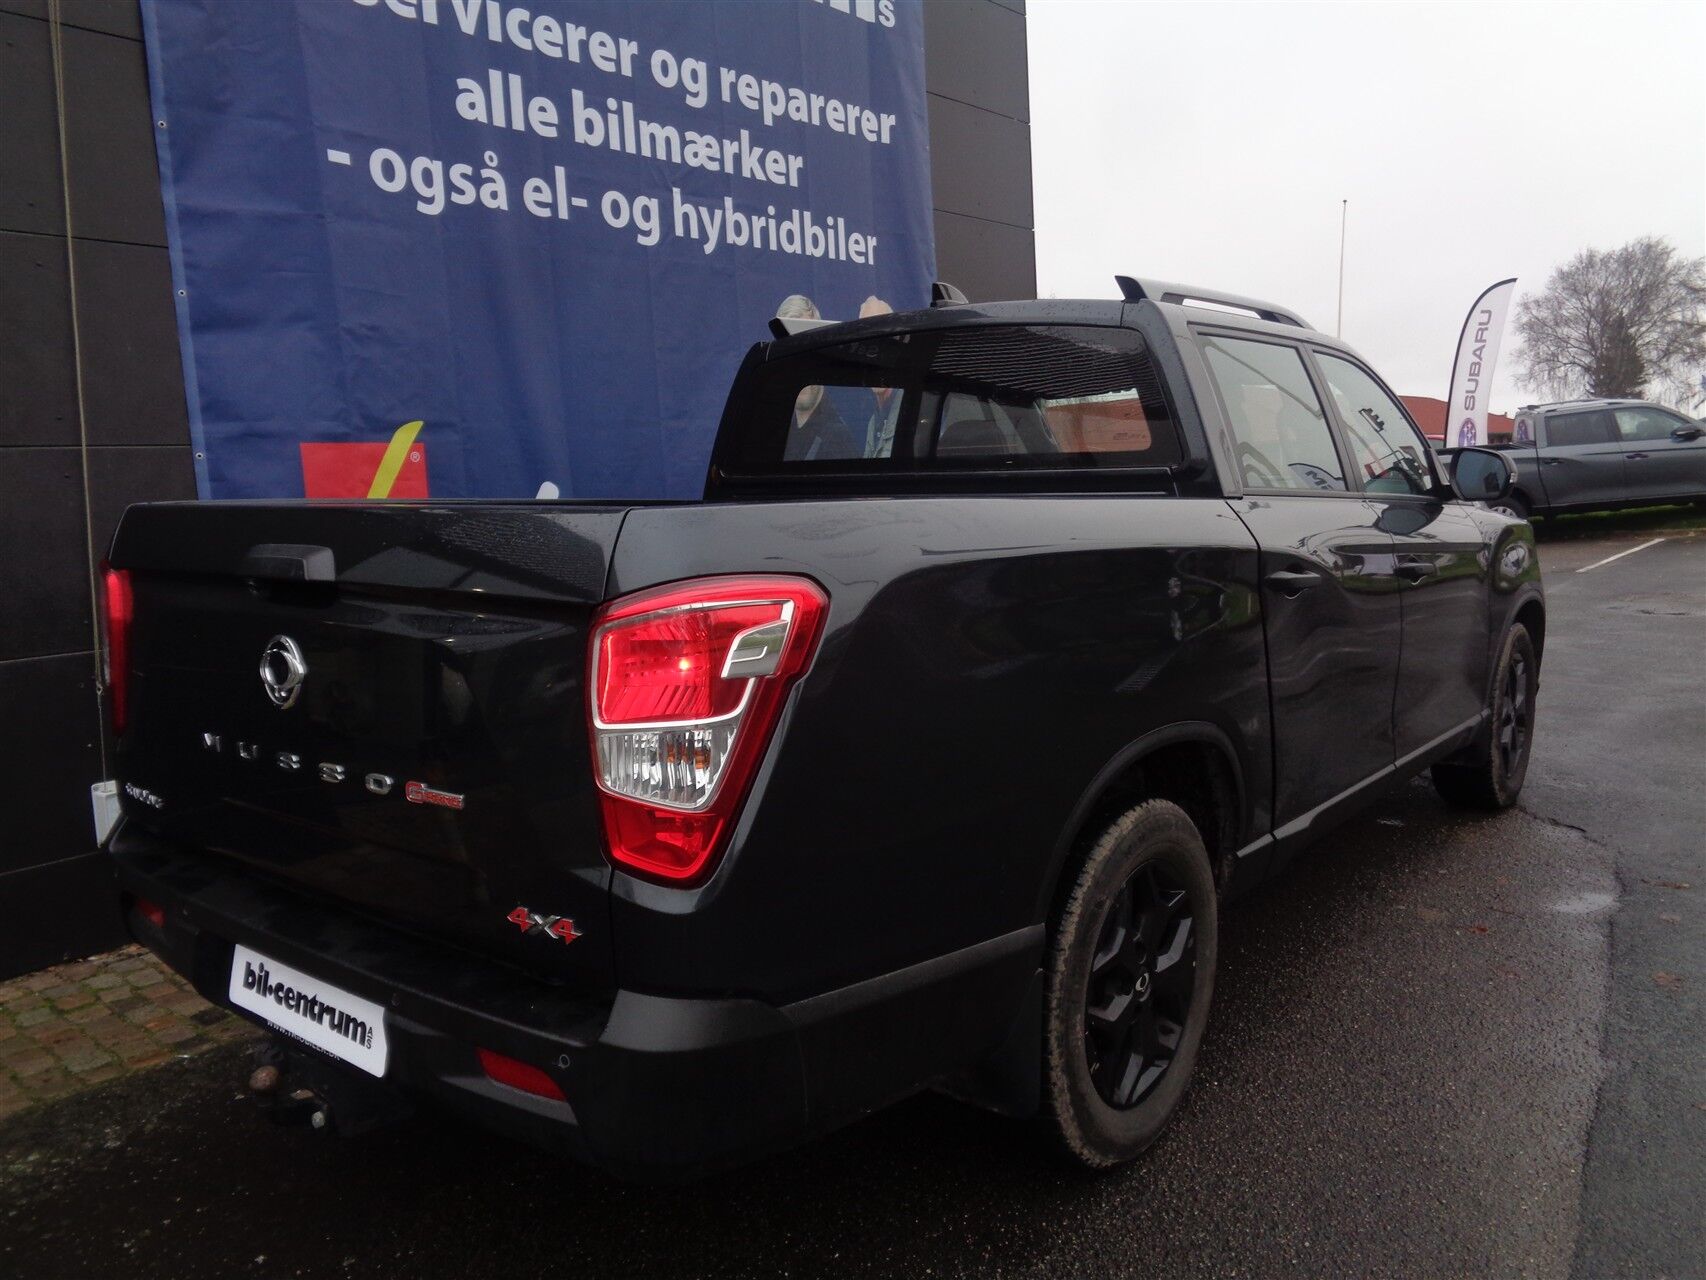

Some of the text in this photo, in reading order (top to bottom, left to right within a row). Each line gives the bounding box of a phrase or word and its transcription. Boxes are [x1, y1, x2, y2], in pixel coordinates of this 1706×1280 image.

[354, 0, 896, 144] rvicerer og reparerer
[455, 68, 804, 188] alle bilmærker
[369, 147, 508, 216] også
[523, 165, 588, 220] el-
[601, 190, 660, 246] og
[672, 187, 878, 265] hybridbiler
[1464, 309, 1493, 411] SUBARU
[204, 732, 392, 796] MUSSO
